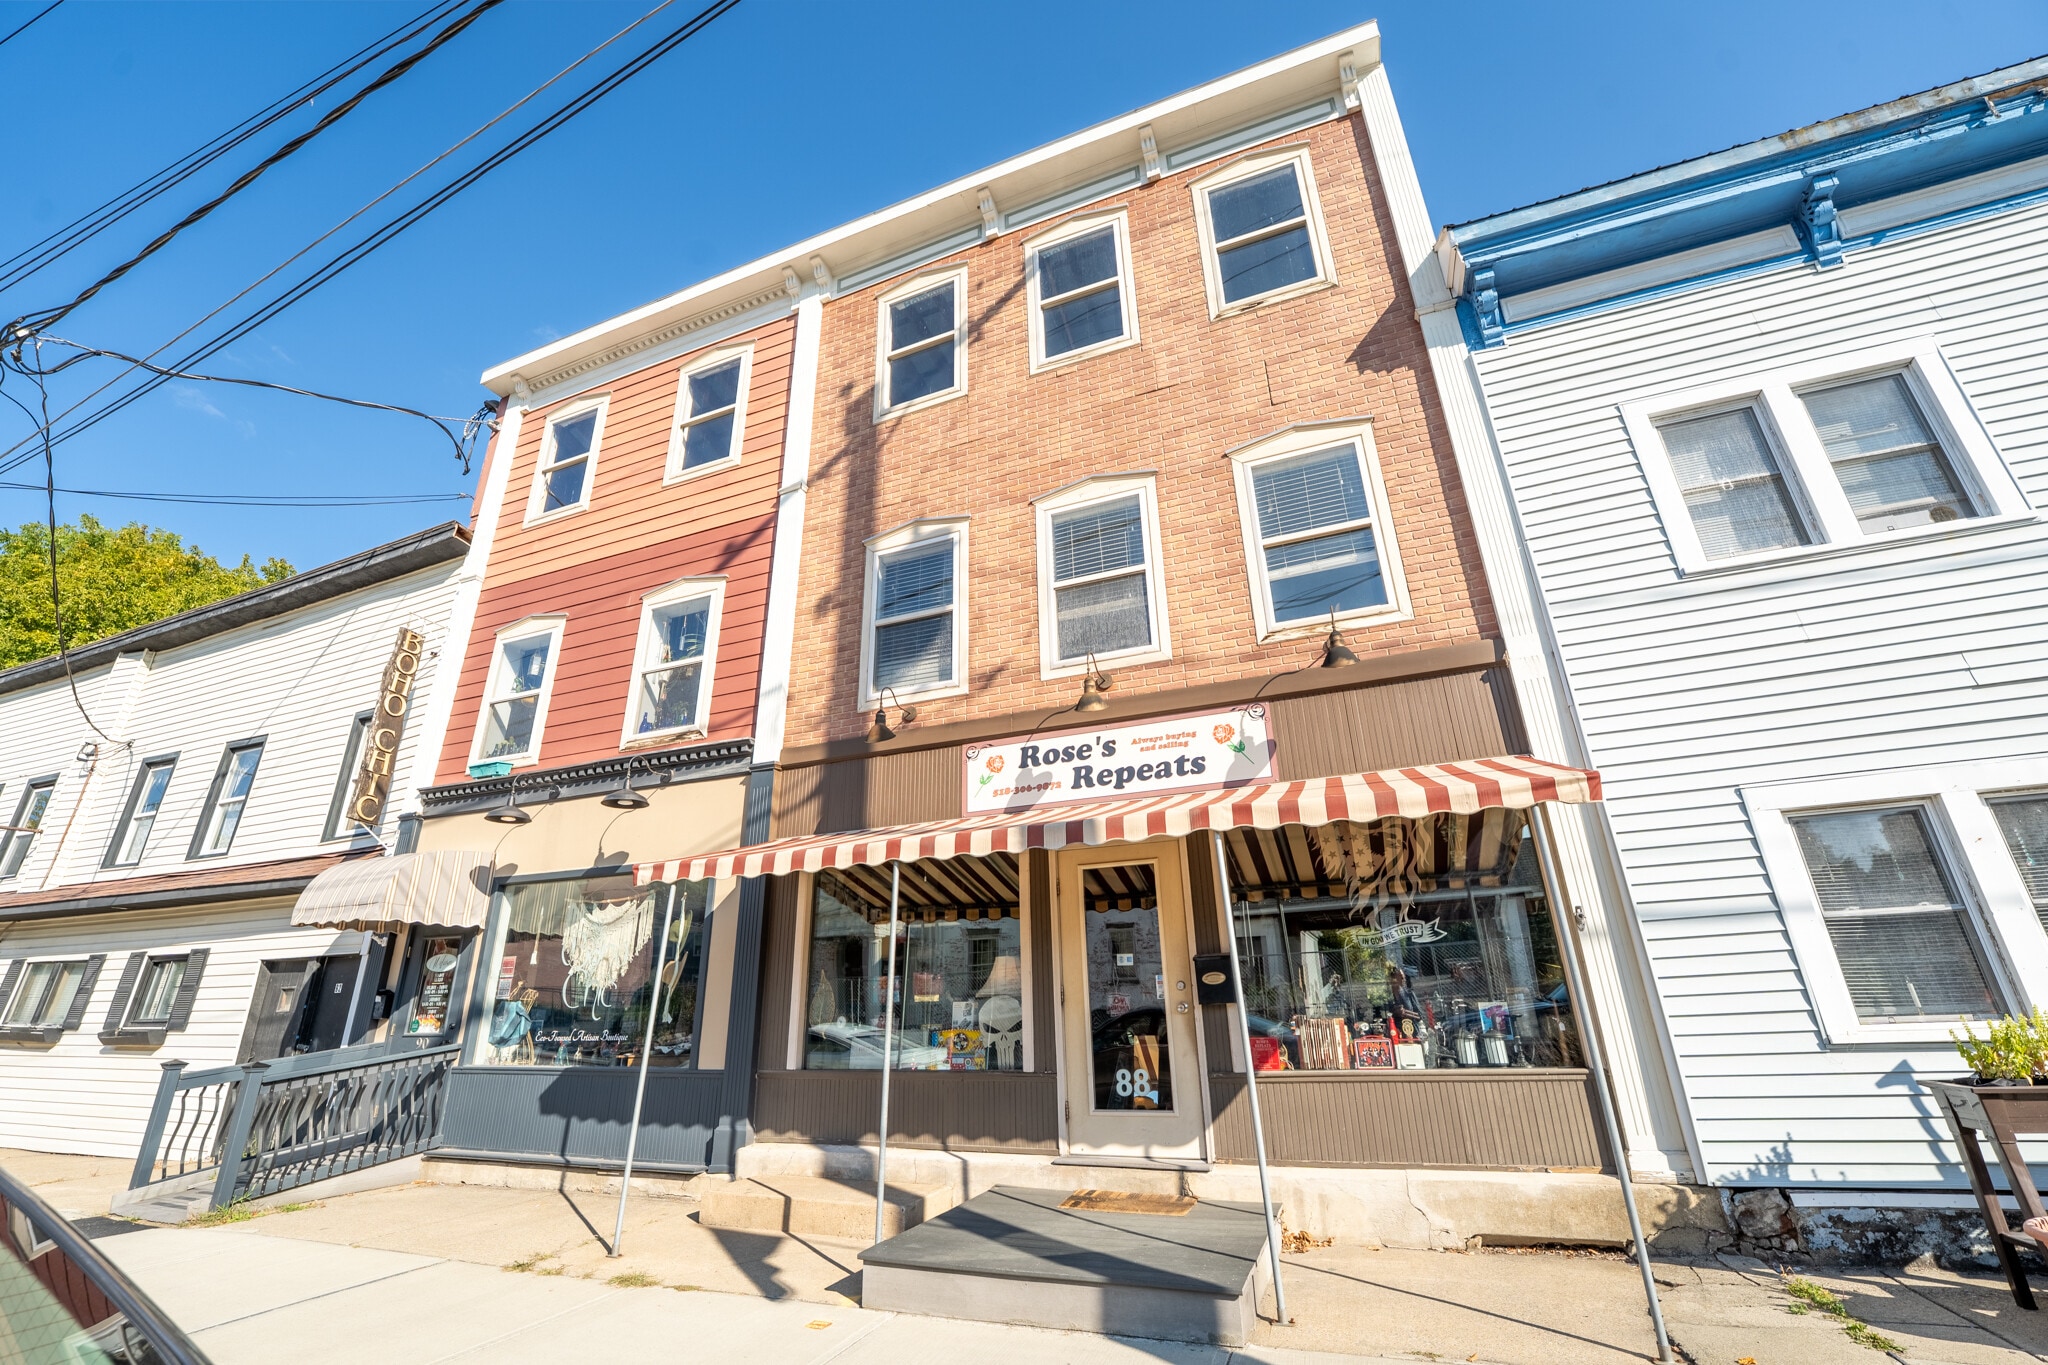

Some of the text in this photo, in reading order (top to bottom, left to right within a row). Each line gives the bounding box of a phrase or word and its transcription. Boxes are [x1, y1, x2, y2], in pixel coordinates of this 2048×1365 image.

[356, 630, 423, 821] BOHO CHIC
[1131, 731, 1197, 746] Always buying
[1140, 740, 1190, 752] and selling
[1018, 736, 1116, 769] Rose's
[1071, 753, 1206, 790] Repeats
[1362, 937, 1369, 945] IN
[1384, 931, 1395, 941] WE
[1395, 925, 1418, 936] TRUST
[416, 1037, 430, 1050] 90
[535, 1028, 629, 1044] Eco-Focused Artisan Boutique
[1116, 1068, 1151, 1097] 88
